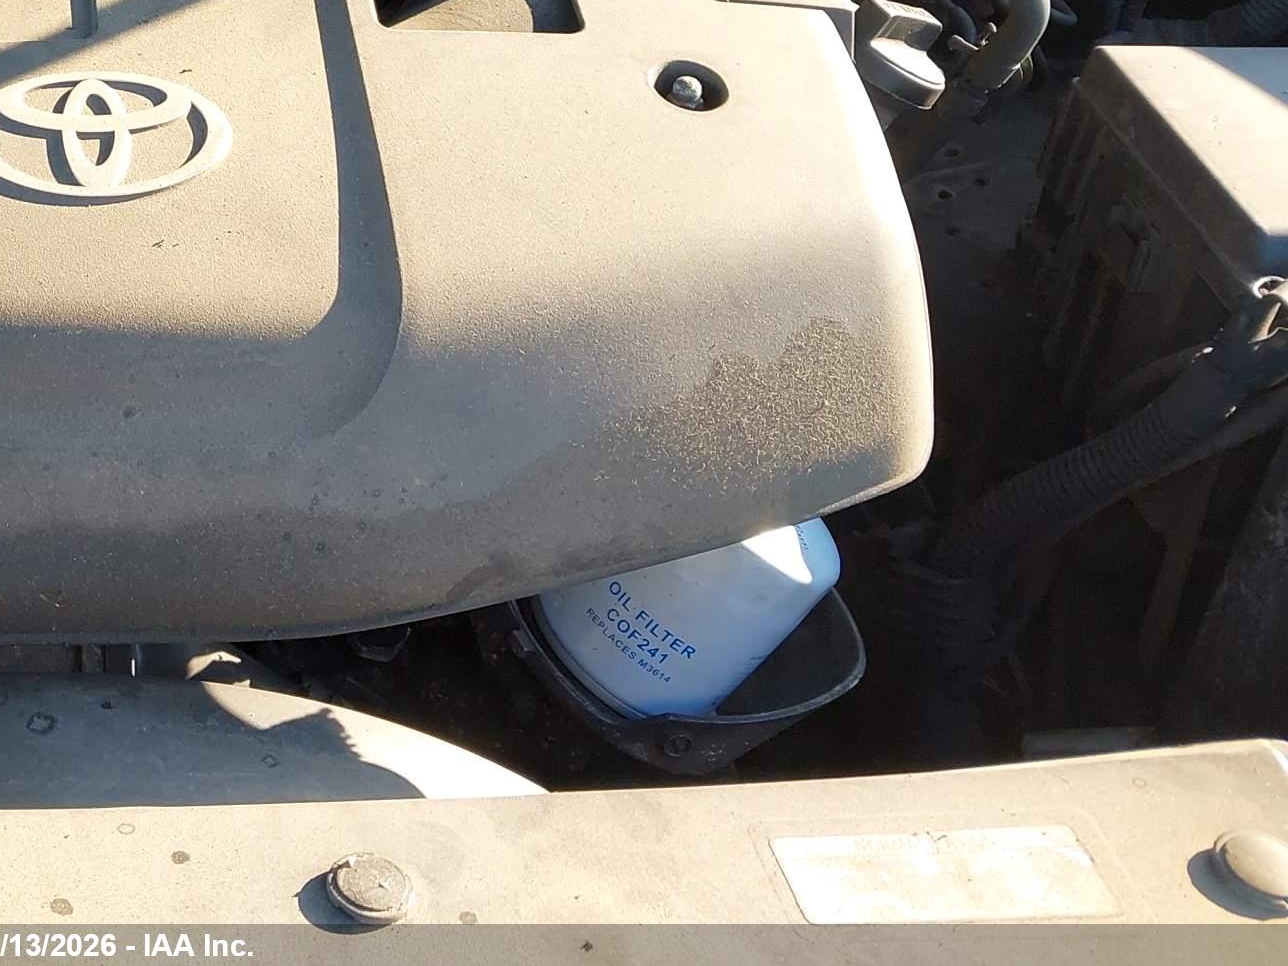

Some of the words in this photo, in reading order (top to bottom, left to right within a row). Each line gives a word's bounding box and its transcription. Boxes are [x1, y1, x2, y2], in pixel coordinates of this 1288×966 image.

[586, 608, 637, 660] REPLACES
[638, 659, 672, 683] M3614
[607, 608, 670, 664] COF241
[609, 581, 632, 611] OIL
[635, 610, 697, 659] FILTER
